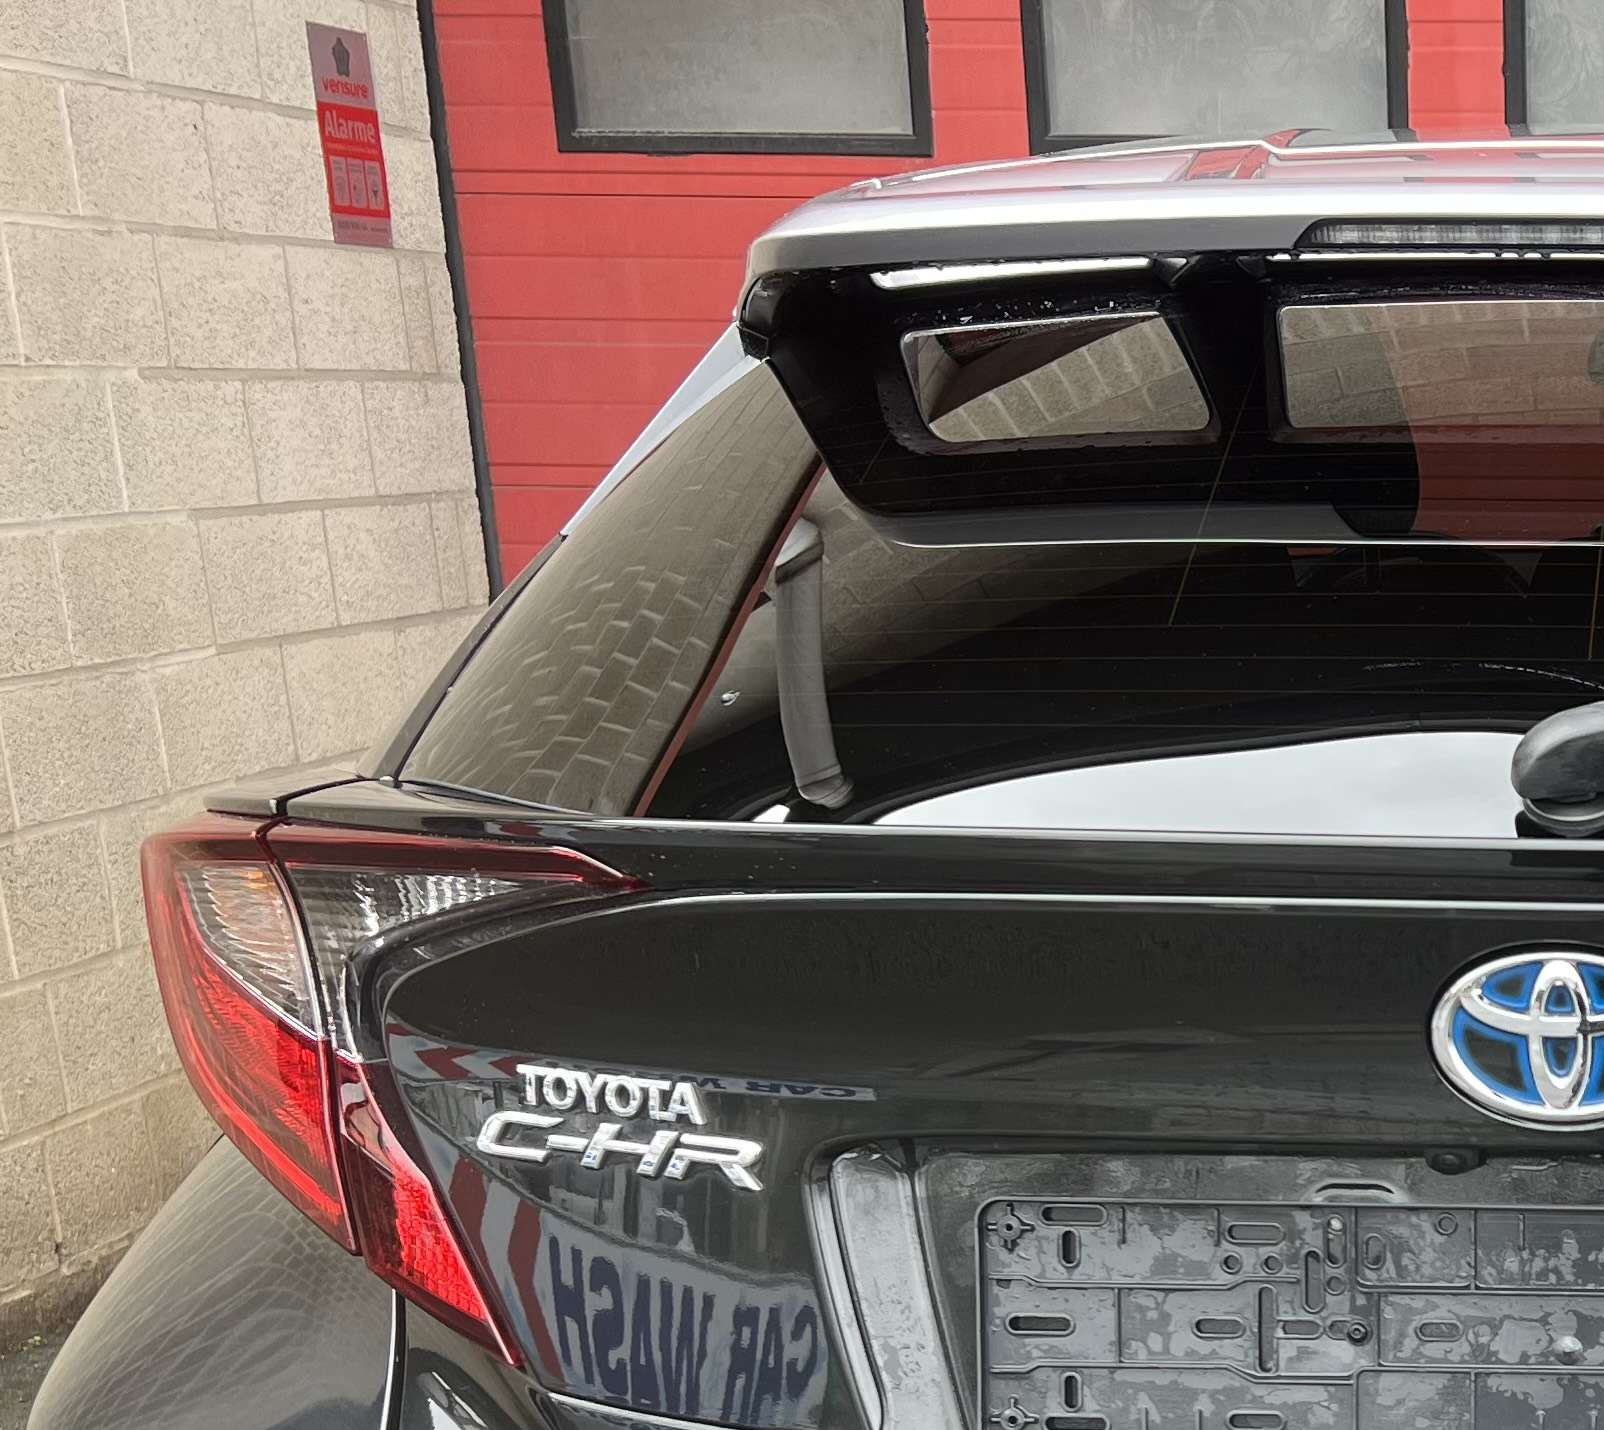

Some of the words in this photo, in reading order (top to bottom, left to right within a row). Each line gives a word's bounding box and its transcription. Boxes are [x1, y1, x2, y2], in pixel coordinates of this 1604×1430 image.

[324, 111, 376, 143] Alarme
[515, 1063, 707, 1125] TOYOTA
[476, 1111, 764, 1191] C-HR
